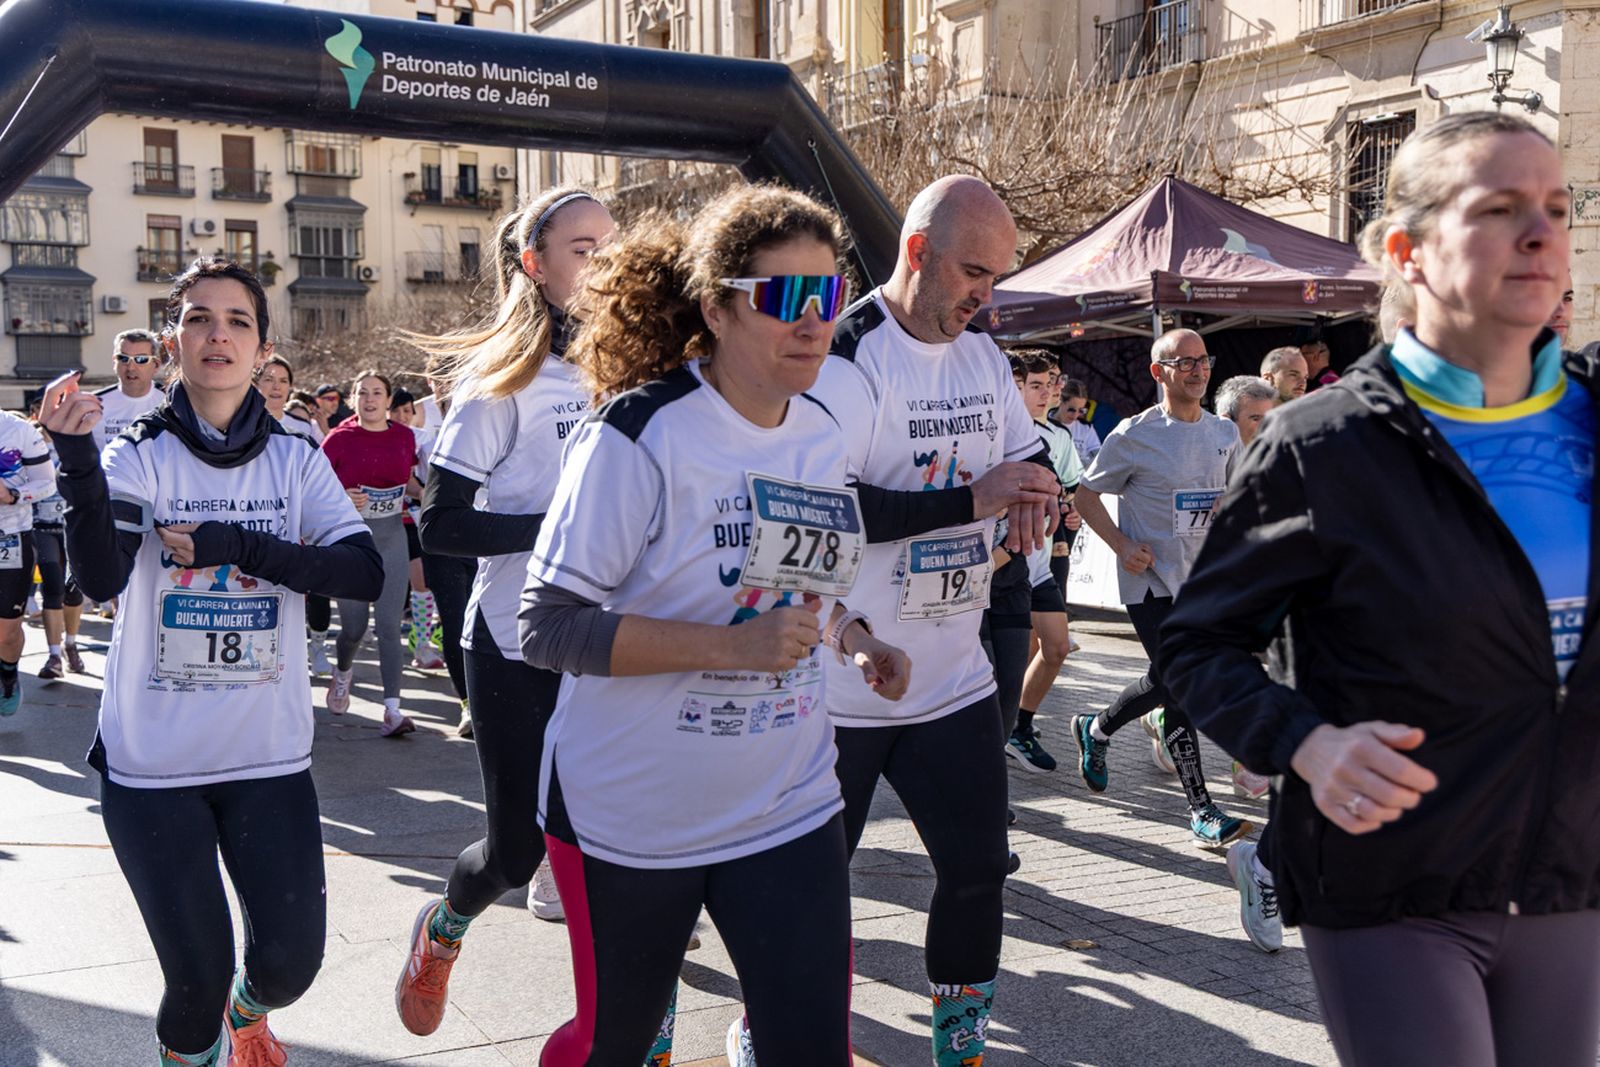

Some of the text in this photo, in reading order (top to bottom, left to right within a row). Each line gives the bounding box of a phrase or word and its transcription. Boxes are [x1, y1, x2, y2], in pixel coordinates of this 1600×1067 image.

[382, 51, 598, 91] Patronato Municipal de
[382, 75, 550, 108] Deportes de Jaén
[552, 403, 565, 415] VI
[907, 400, 918, 412] VI
[176, 498, 237, 513] CARRERA
[370, 501, 395, 512] 456
[715, 497, 730, 514] VI
[767, 499, 834, 526] BUENA MUERTE
[779, 525, 840, 572] 278
[920, 554, 945, 569] BUENA
[941, 569, 967, 601] 19
[177, 599, 271, 610] VI CARRERA CAMINATA
[175, 611, 254, 628] BUENA MUERTE
[205, 632, 242, 664] 18
[702, 672, 760, 683] En beneficio de
[711, 719, 744, 727] BYD
